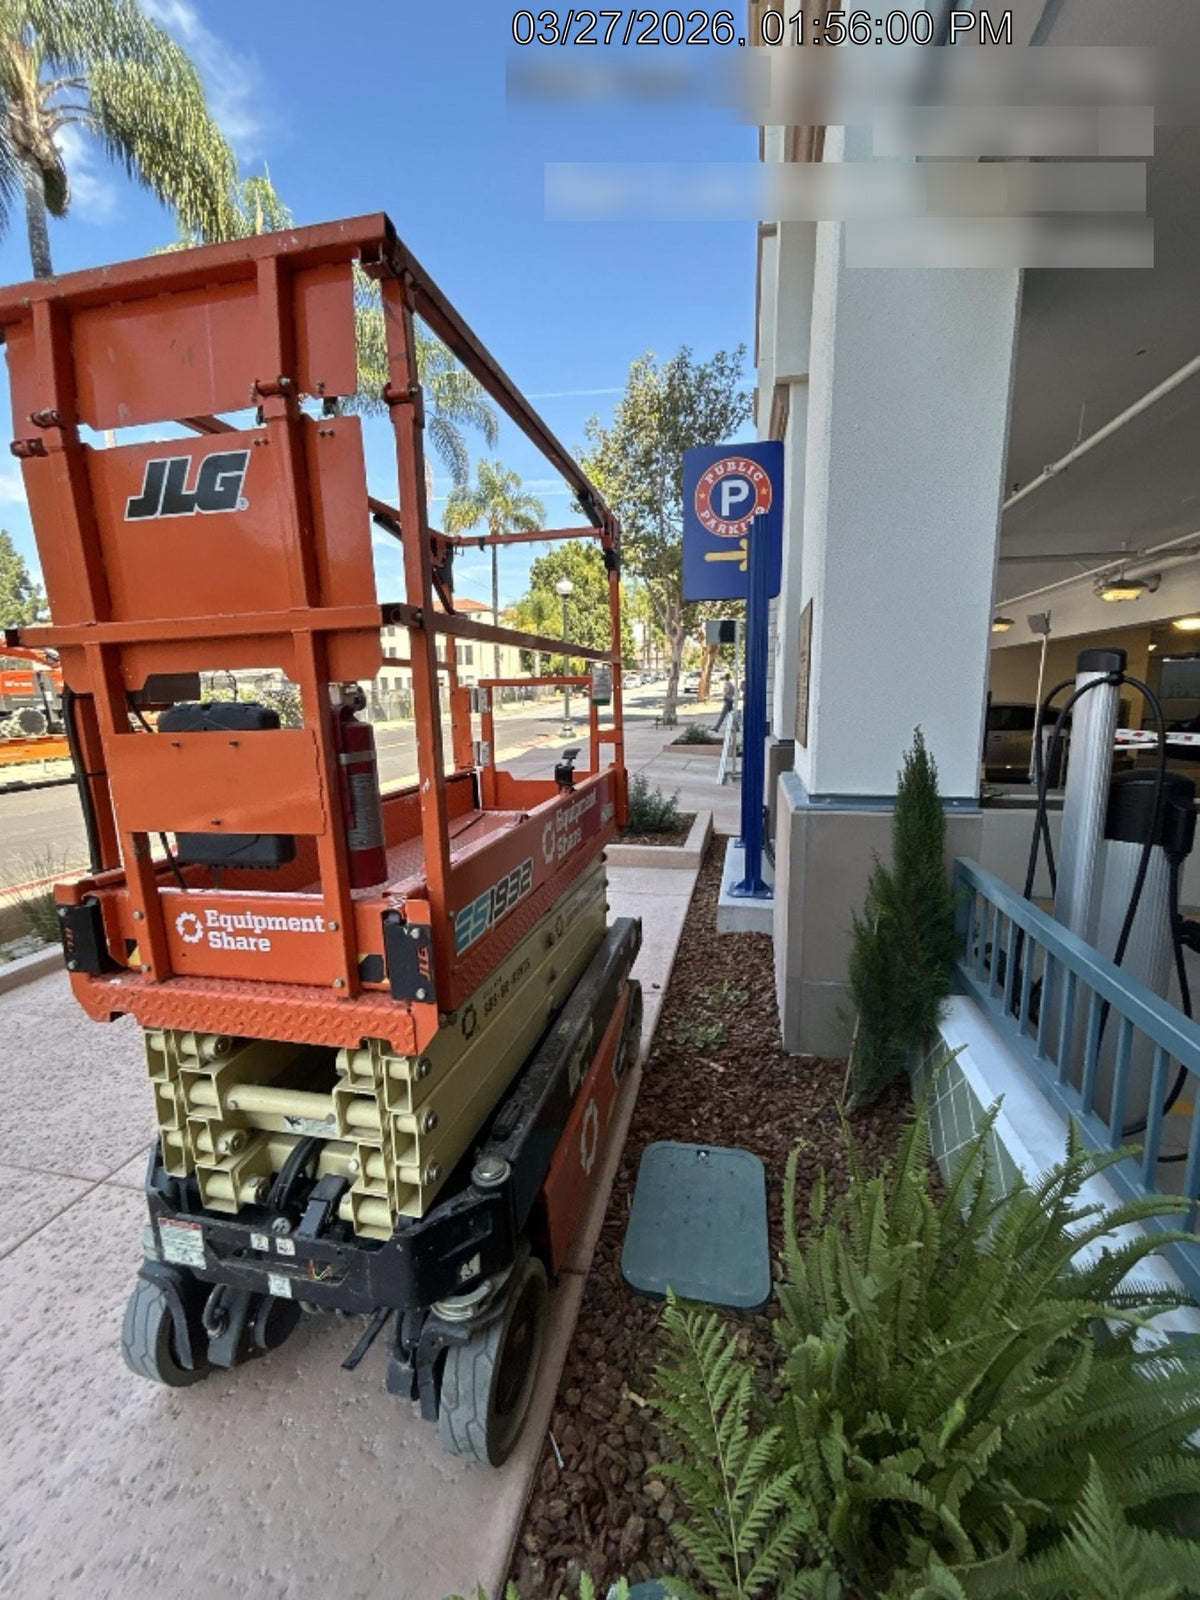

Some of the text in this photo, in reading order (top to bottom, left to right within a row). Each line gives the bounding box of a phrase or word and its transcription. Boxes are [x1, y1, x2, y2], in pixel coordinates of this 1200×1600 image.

[124, 449, 251, 521] JLG
[704, 461, 764, 484] PUBLIC
[721, 479, 750, 517] P
[204, 909, 326, 934] Equipment
[455, 856, 534, 957] ES1932
[207, 931, 271, 952] Share
